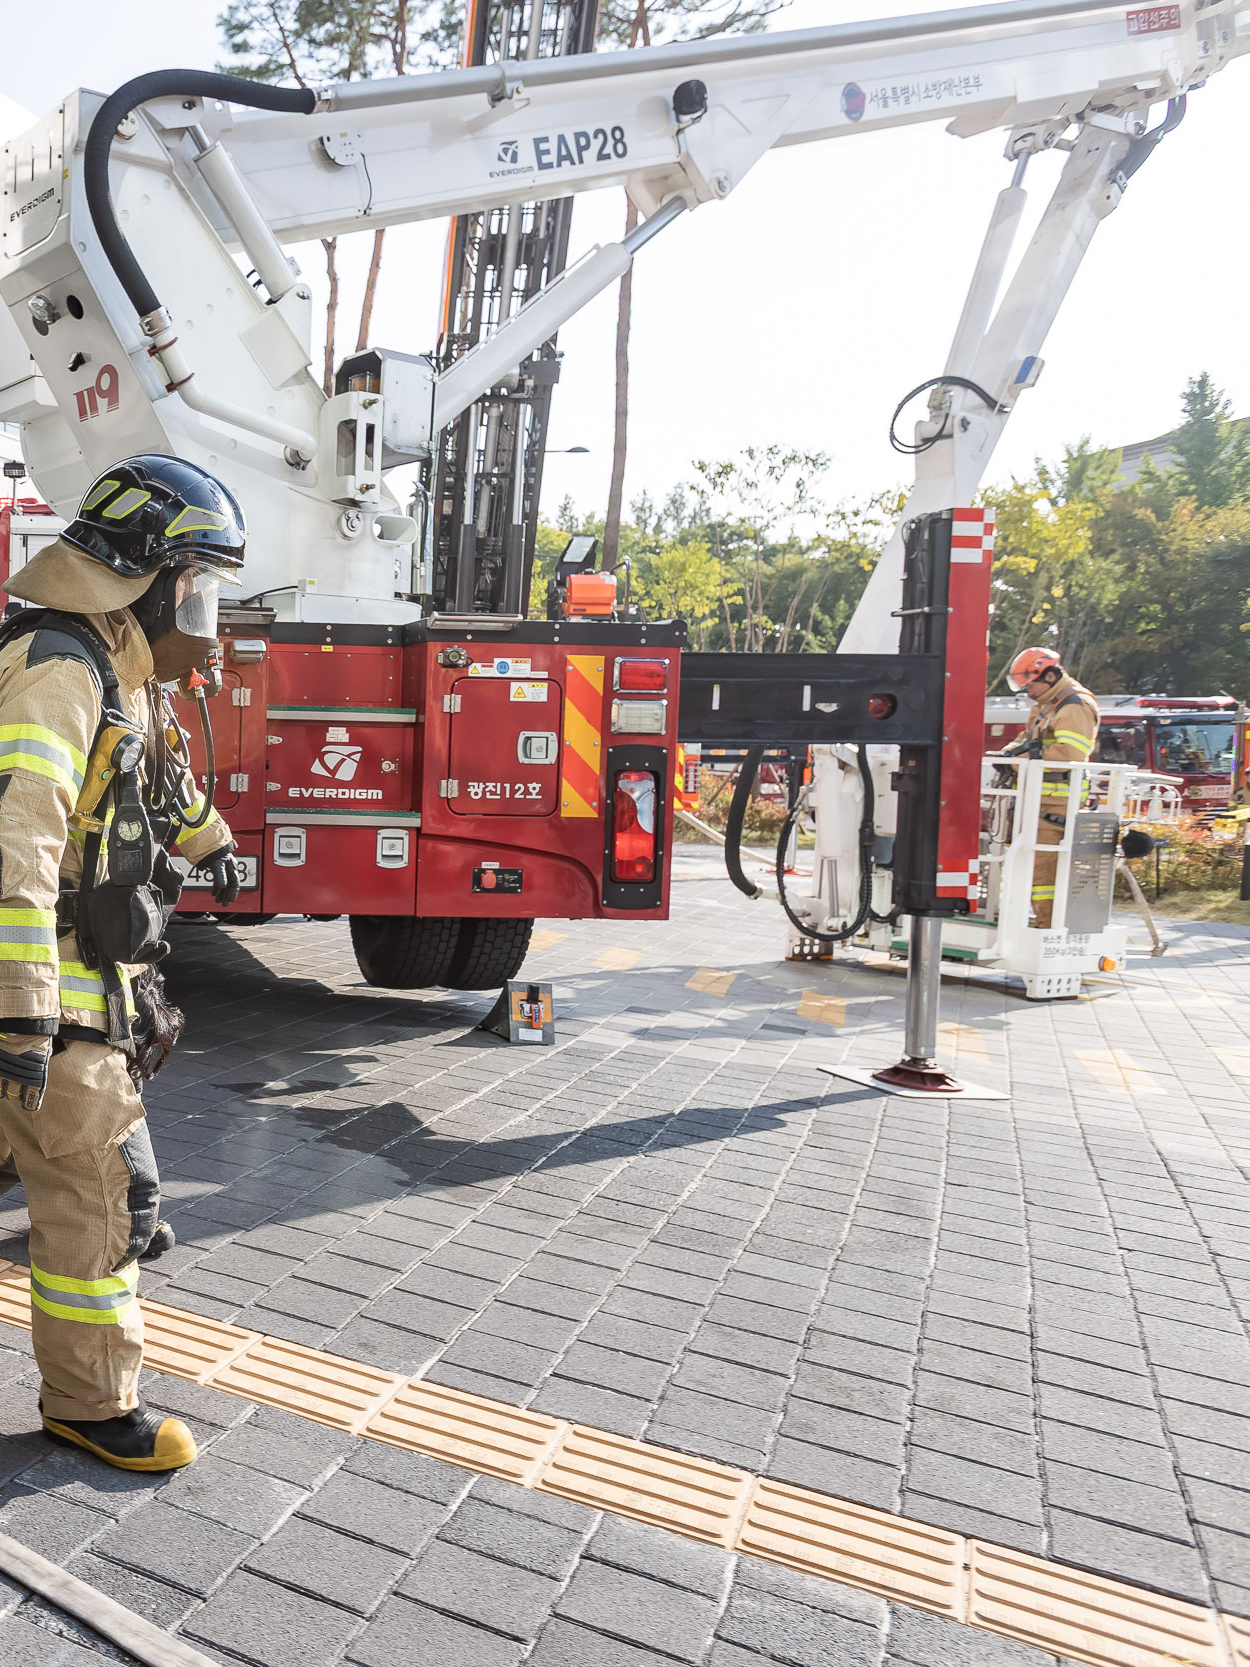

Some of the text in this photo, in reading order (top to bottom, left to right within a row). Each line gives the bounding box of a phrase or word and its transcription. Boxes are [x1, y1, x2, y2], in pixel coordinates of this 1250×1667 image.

[1127, 8, 1180, 32] 고압선주의
[868, 73, 983, 109] 서울특별시 소방재난본부
[532, 125, 628, 171] EAP28
[489, 165, 535, 178] EVERDIGM
[10, 187, 55, 222] EVERDIGM
[72, 363, 120, 423] 119
[288, 787, 383, 800] EVERDIGM
[467, 782, 543, 800] 광진12호
[187, 861, 248, 883] 488
